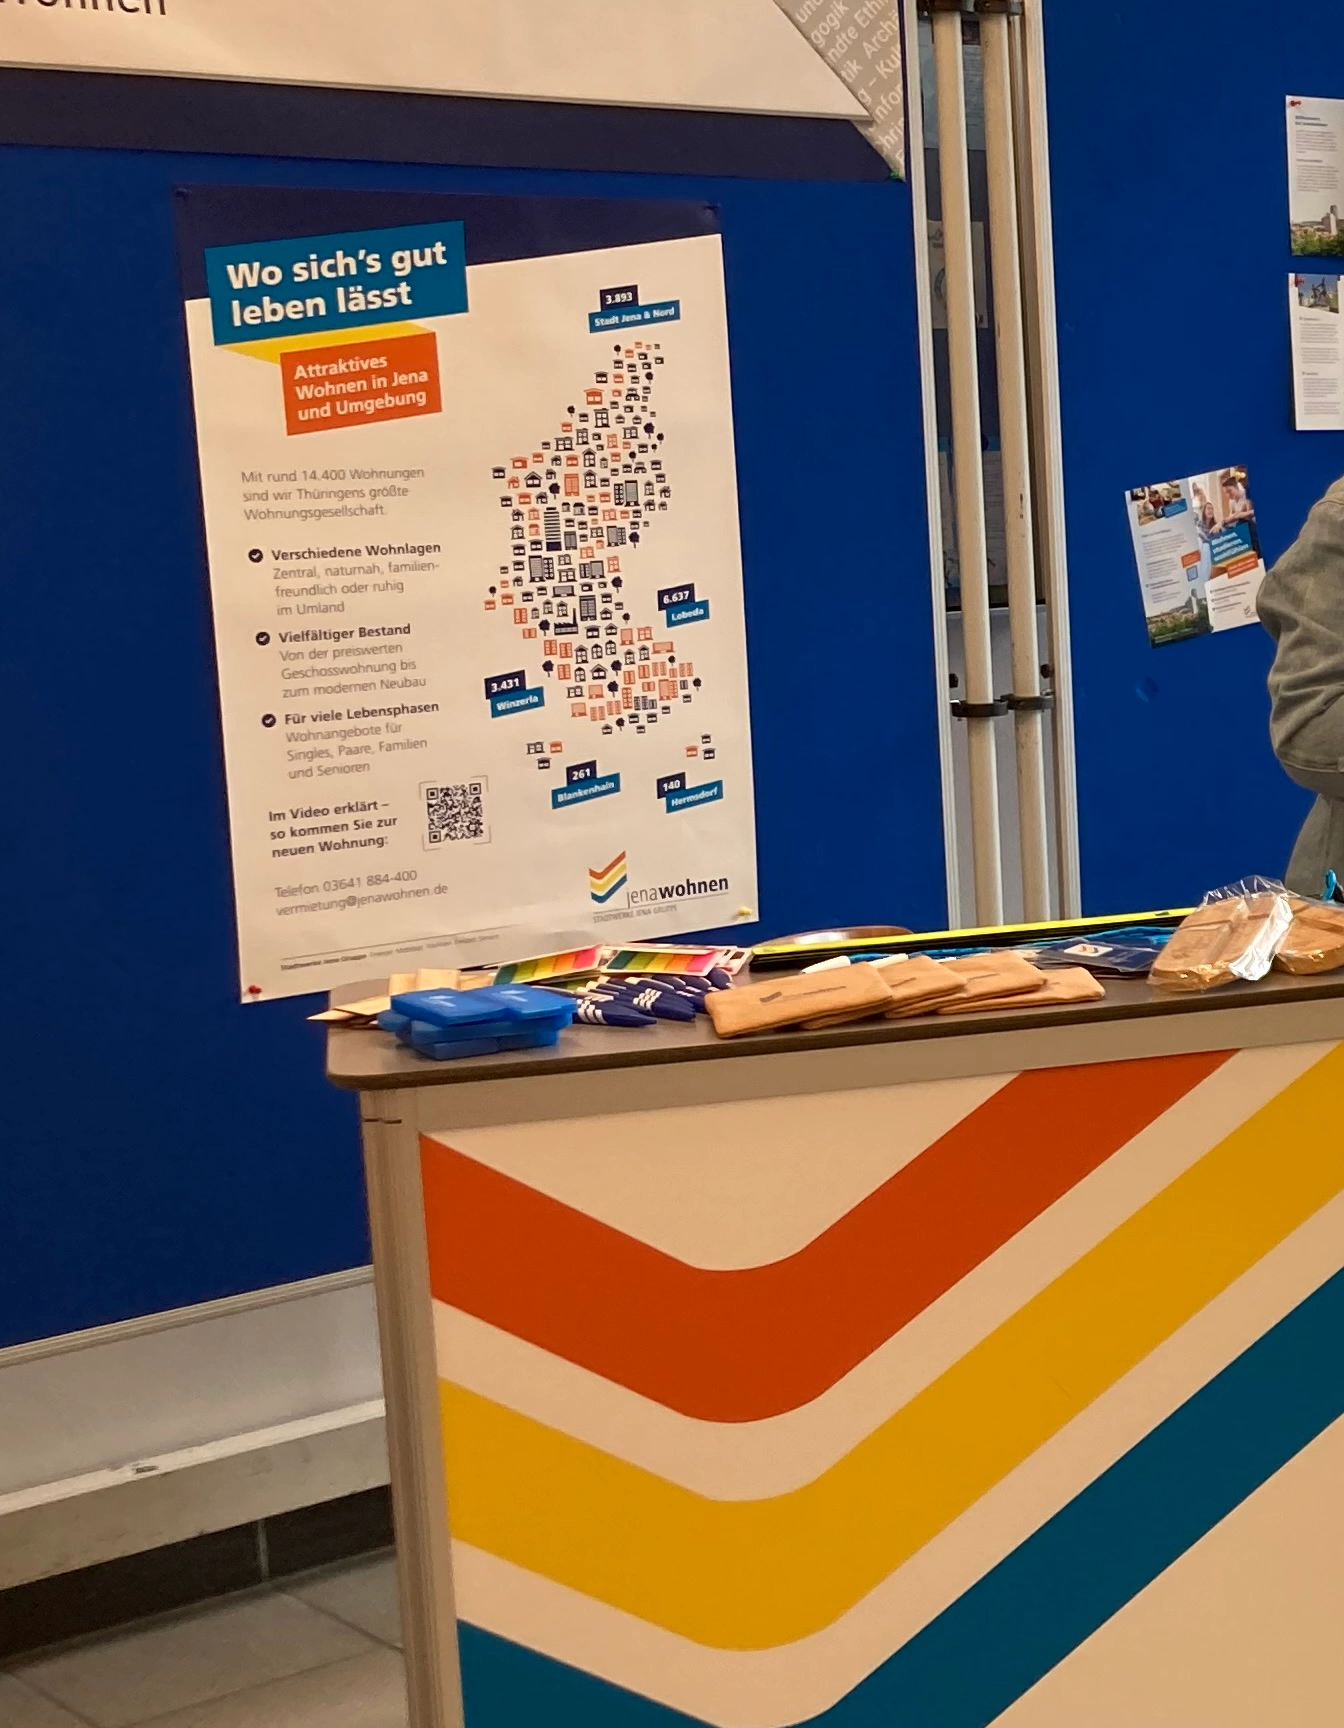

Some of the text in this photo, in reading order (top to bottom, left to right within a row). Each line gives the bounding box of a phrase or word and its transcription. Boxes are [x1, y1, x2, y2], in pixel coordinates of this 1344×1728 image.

[226, 262, 283, 289] Wo
[391, 241, 447, 277] gut
[231, 281, 413, 327] leben lässt
[293, 355, 388, 380] Attraktives
[295, 370, 429, 400] Wohnen in Jena
[297, 390, 427, 421] und Umgebung
[241, 468, 425, 484] Mit rund 14.400 Wohnungen
[242, 485, 409, 502] sind wir Thüringens größte
[243, 504, 387, 521] Wohnungsgesellschaft.
[271, 543, 441, 561] Verschiedene Wohnlagen
[273, 560, 440, 580] Zentral, naturnah, familien-
[275, 580, 405, 598] freundlich oder ruhig
[276, 601, 345, 616] im Umland
[278, 623, 411, 643] Vielfältiger Bestand
[279, 643, 403, 662] Von der preiswerten
[281, 658, 417, 680] Geschosswohnung bis
[282, 677, 427, 699] zum modernen Neubau
[284, 701, 440, 726] Für viele Lebensphasen
[495, 693, 539, 712] Winzerla
[286, 722, 402, 743] Wohnangebote für
[286, 748, 334, 762] Singles,
[378, 738, 428, 753] Familien
[288, 762, 371, 780] und Senioren
[556, 779, 615, 803] Blankenhain
[268, 809, 286, 822] Im
[289, 805, 330, 820] Video
[333, 800, 379, 816] erklärt
[270, 816, 398, 840] so kommen Sie zur
[271, 835, 389, 858] neuen Wohnung:
[274, 869, 418, 899] Telefon 03641 884-400
[626, 877, 729, 909] jenawohnen
[276, 883, 449, 916] vermietung@jenawohnen.de
